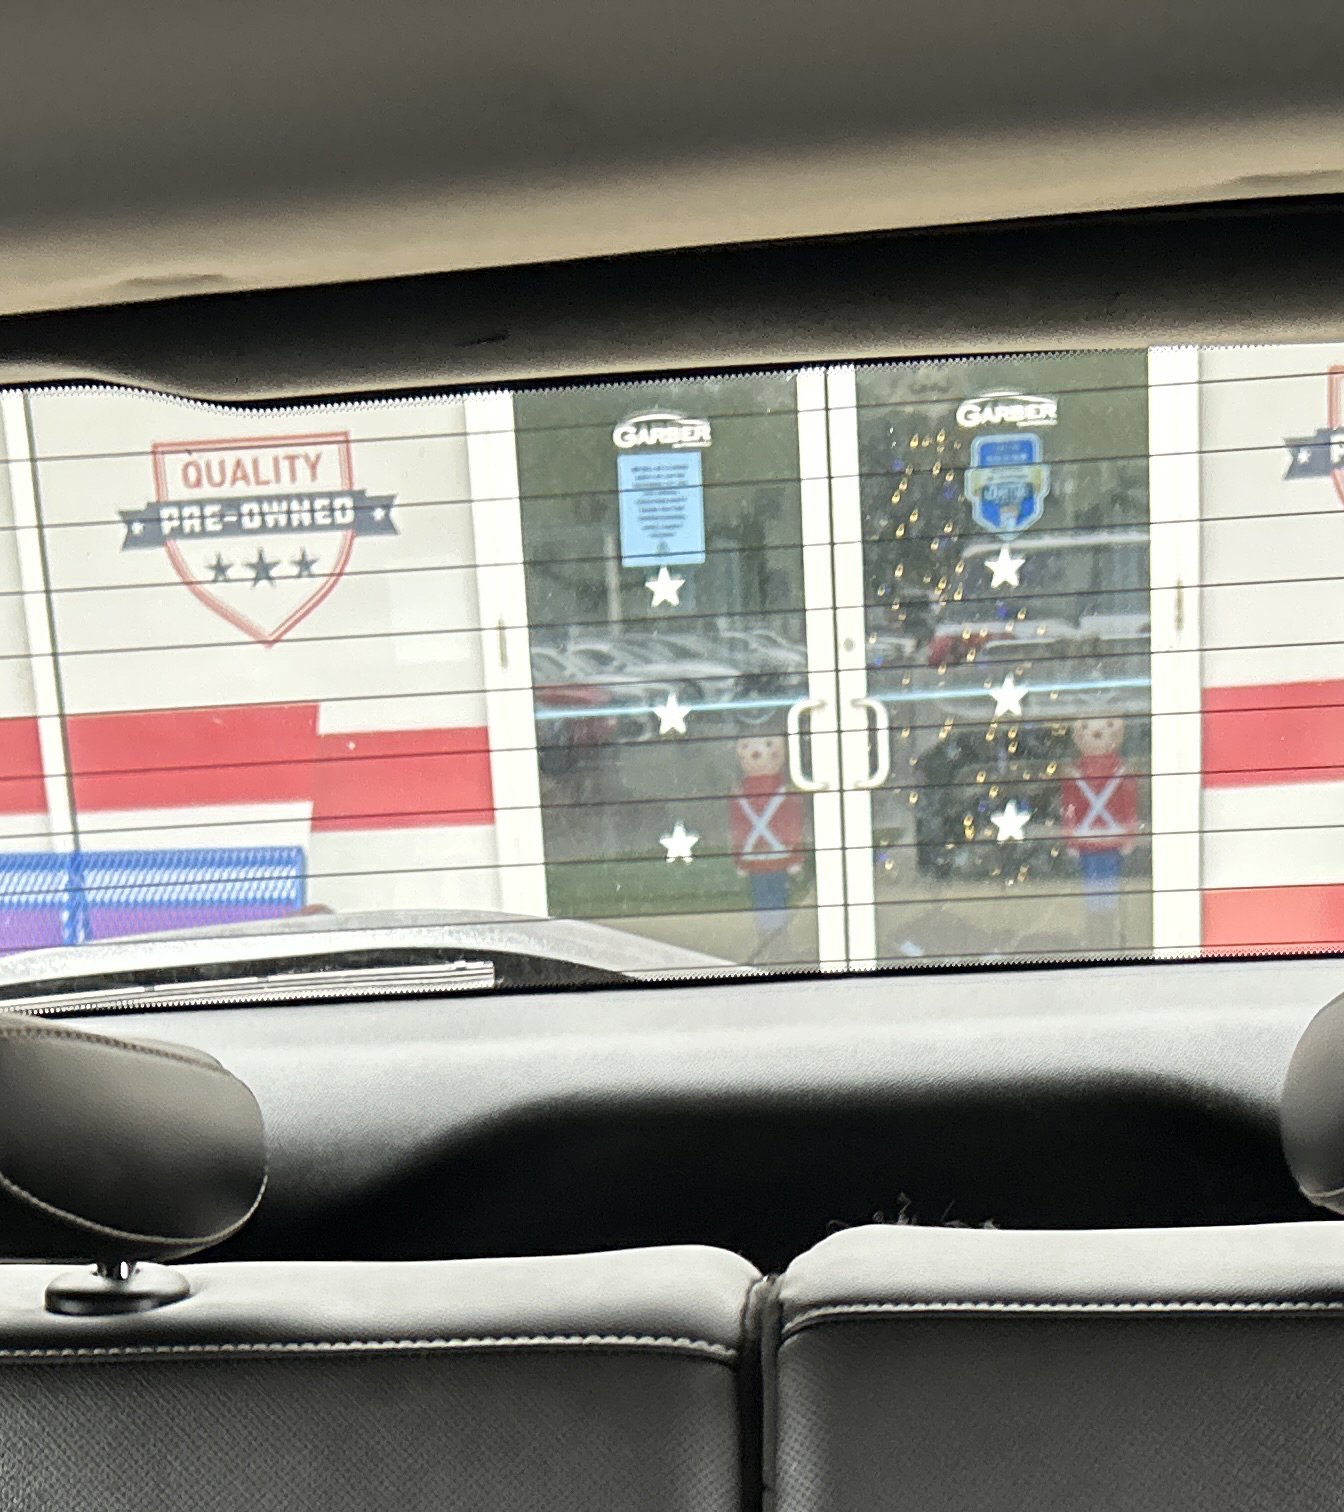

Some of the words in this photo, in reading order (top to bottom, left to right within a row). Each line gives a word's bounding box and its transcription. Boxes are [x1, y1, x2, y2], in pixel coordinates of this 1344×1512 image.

[956, 402, 1058, 428] GARBER
[180, 452, 324, 489] QUALITY
[158, 495, 356, 536] PRE-OWNED
